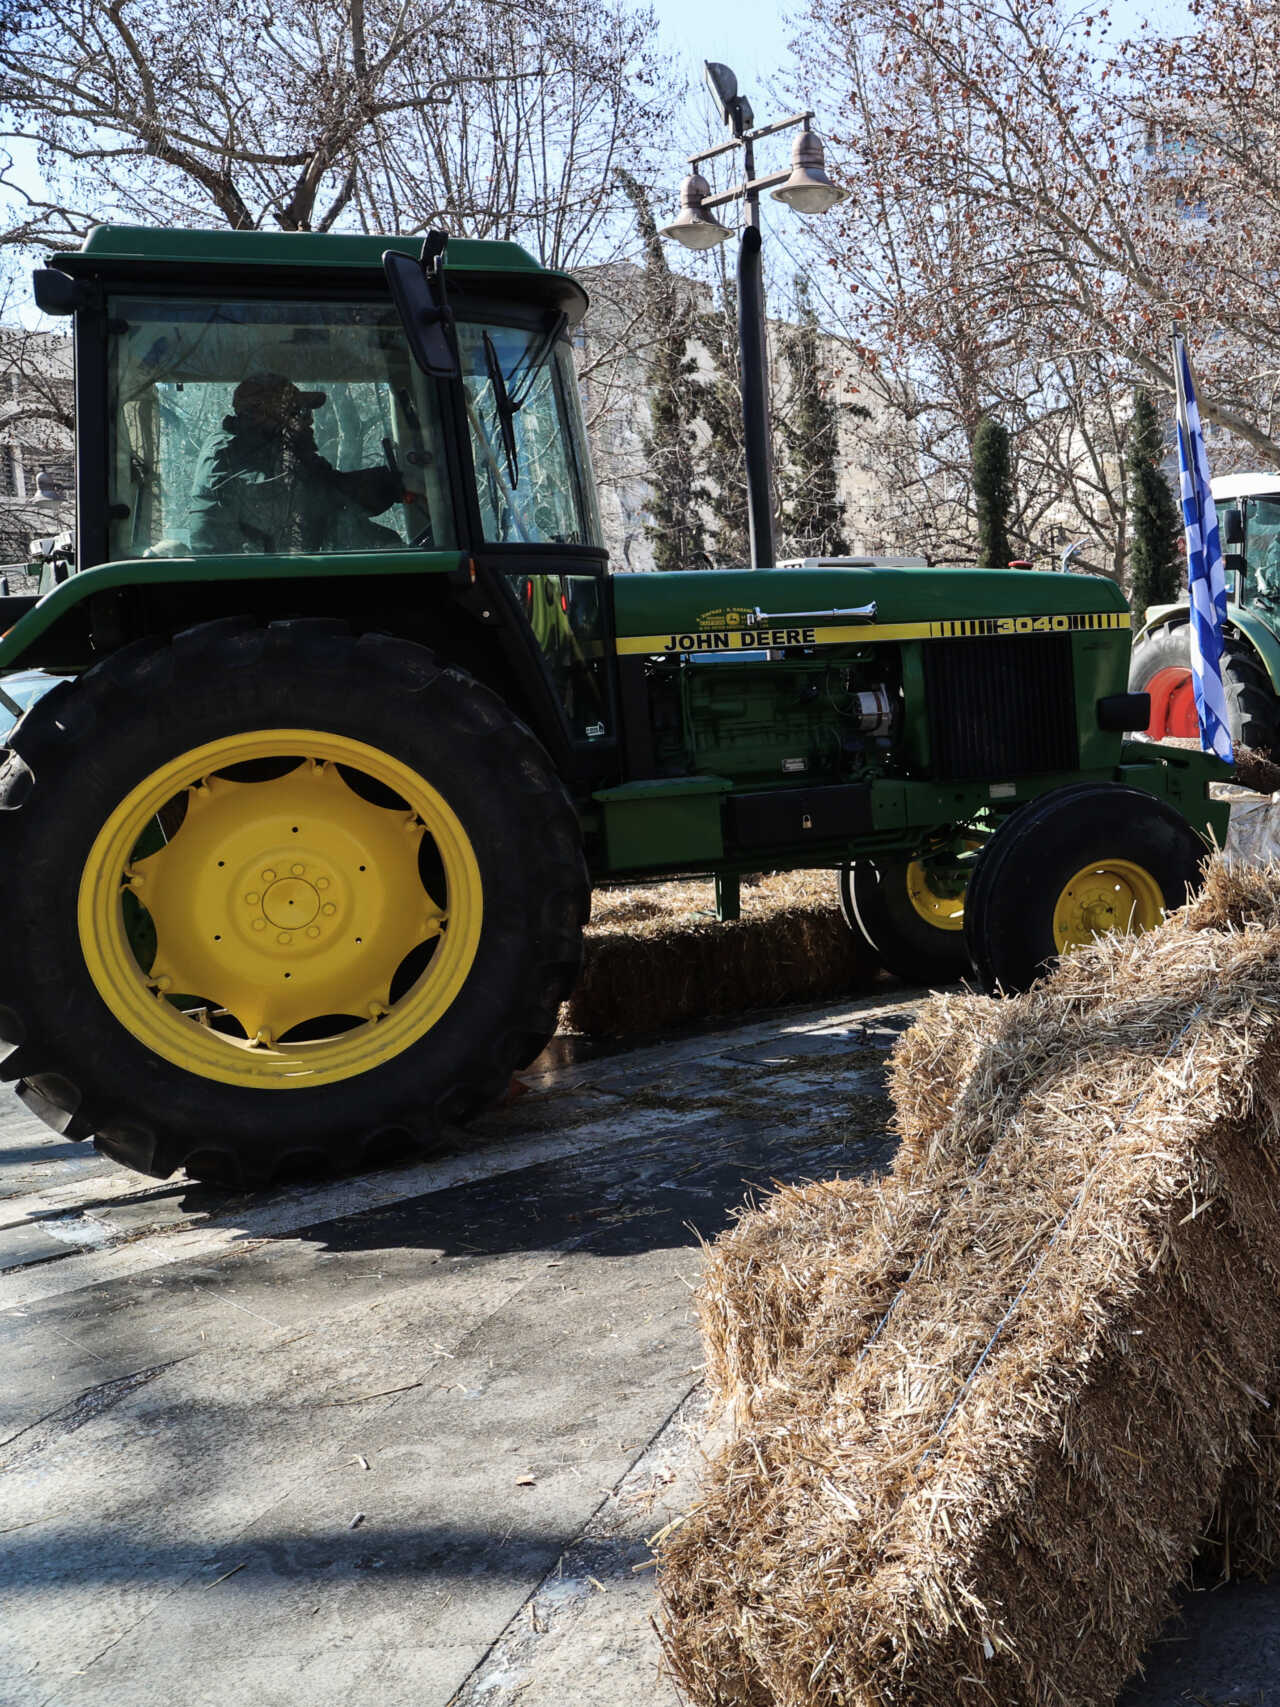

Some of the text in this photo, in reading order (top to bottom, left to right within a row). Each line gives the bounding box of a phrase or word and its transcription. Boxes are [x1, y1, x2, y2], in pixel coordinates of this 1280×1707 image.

[997, 616, 1069, 633] 3040
[664, 628, 816, 651] JOHN DEERE
